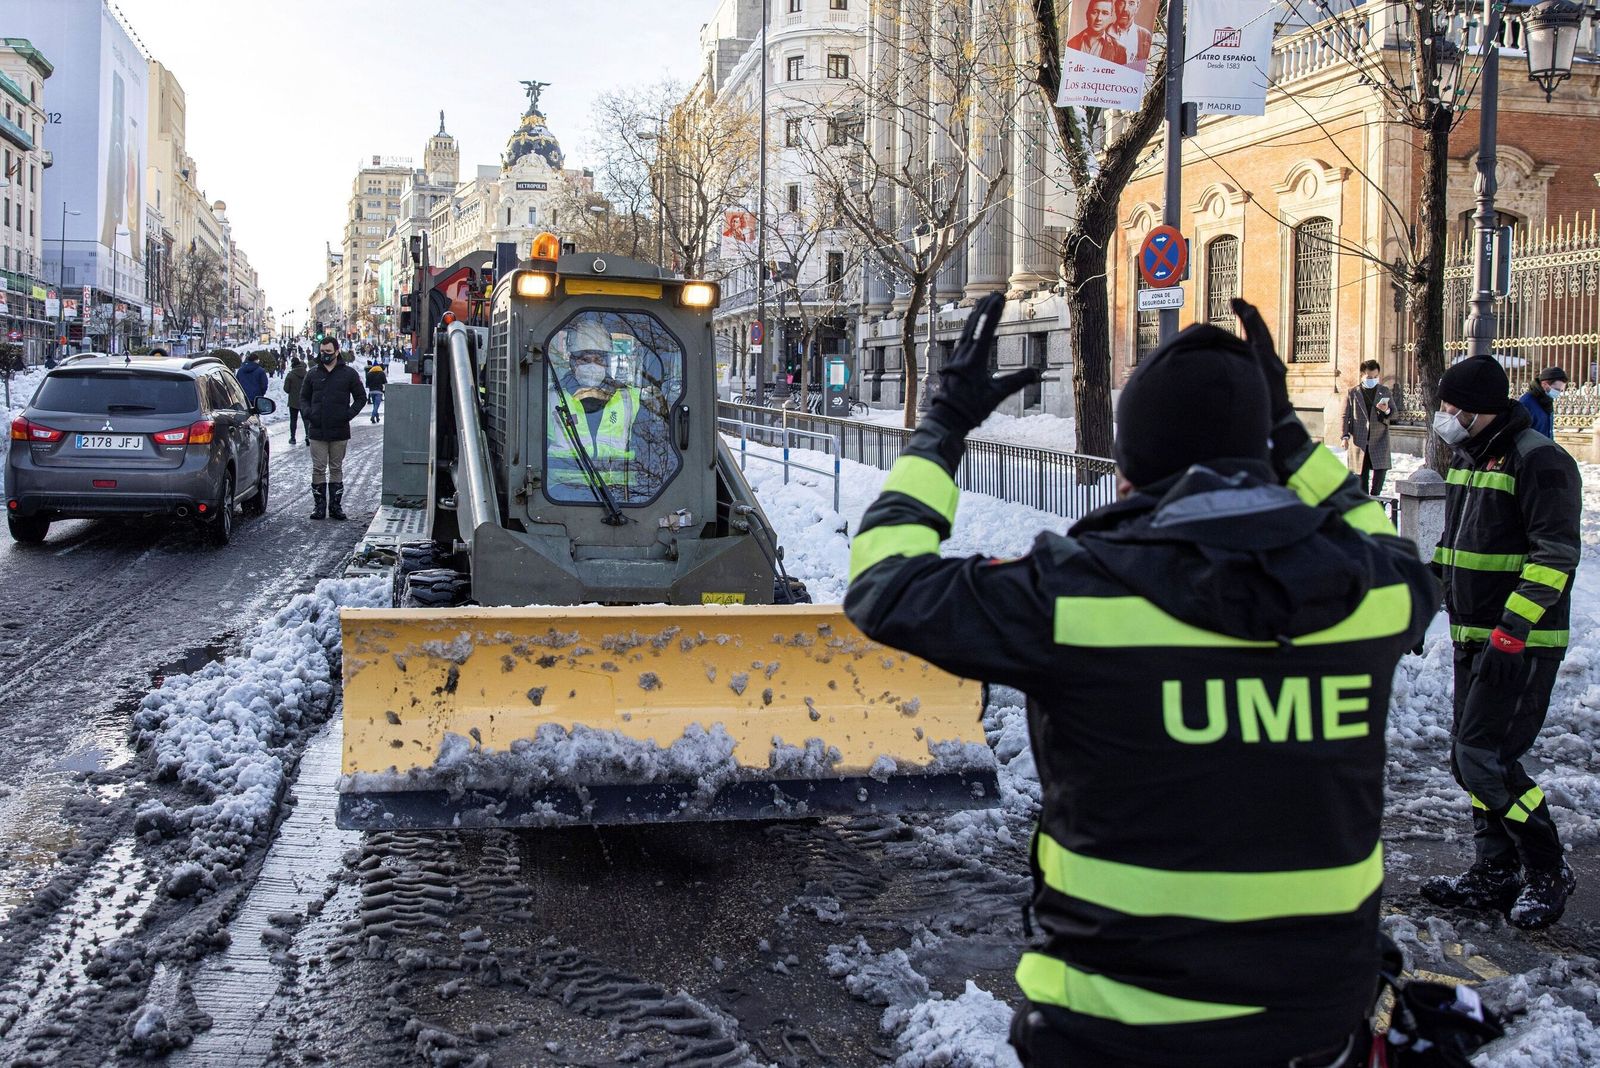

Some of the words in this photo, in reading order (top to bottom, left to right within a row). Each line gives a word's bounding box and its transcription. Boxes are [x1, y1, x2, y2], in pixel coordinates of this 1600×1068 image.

[1223, 54, 1257, 62] ESPAÑOL
[1073, 64, 1086, 72] dic
[1065, 79, 1079, 90] Los
[1081, 81, 1139, 94] asquerosos
[1083, 95, 1099, 103] David
[1207, 103, 1241, 111] MADRID
[48, 112, 62, 124] 12
[82, 436, 112, 448] 2178
[118, 437, 140, 448] JFJ
[1162, 674, 1372, 744] UME
